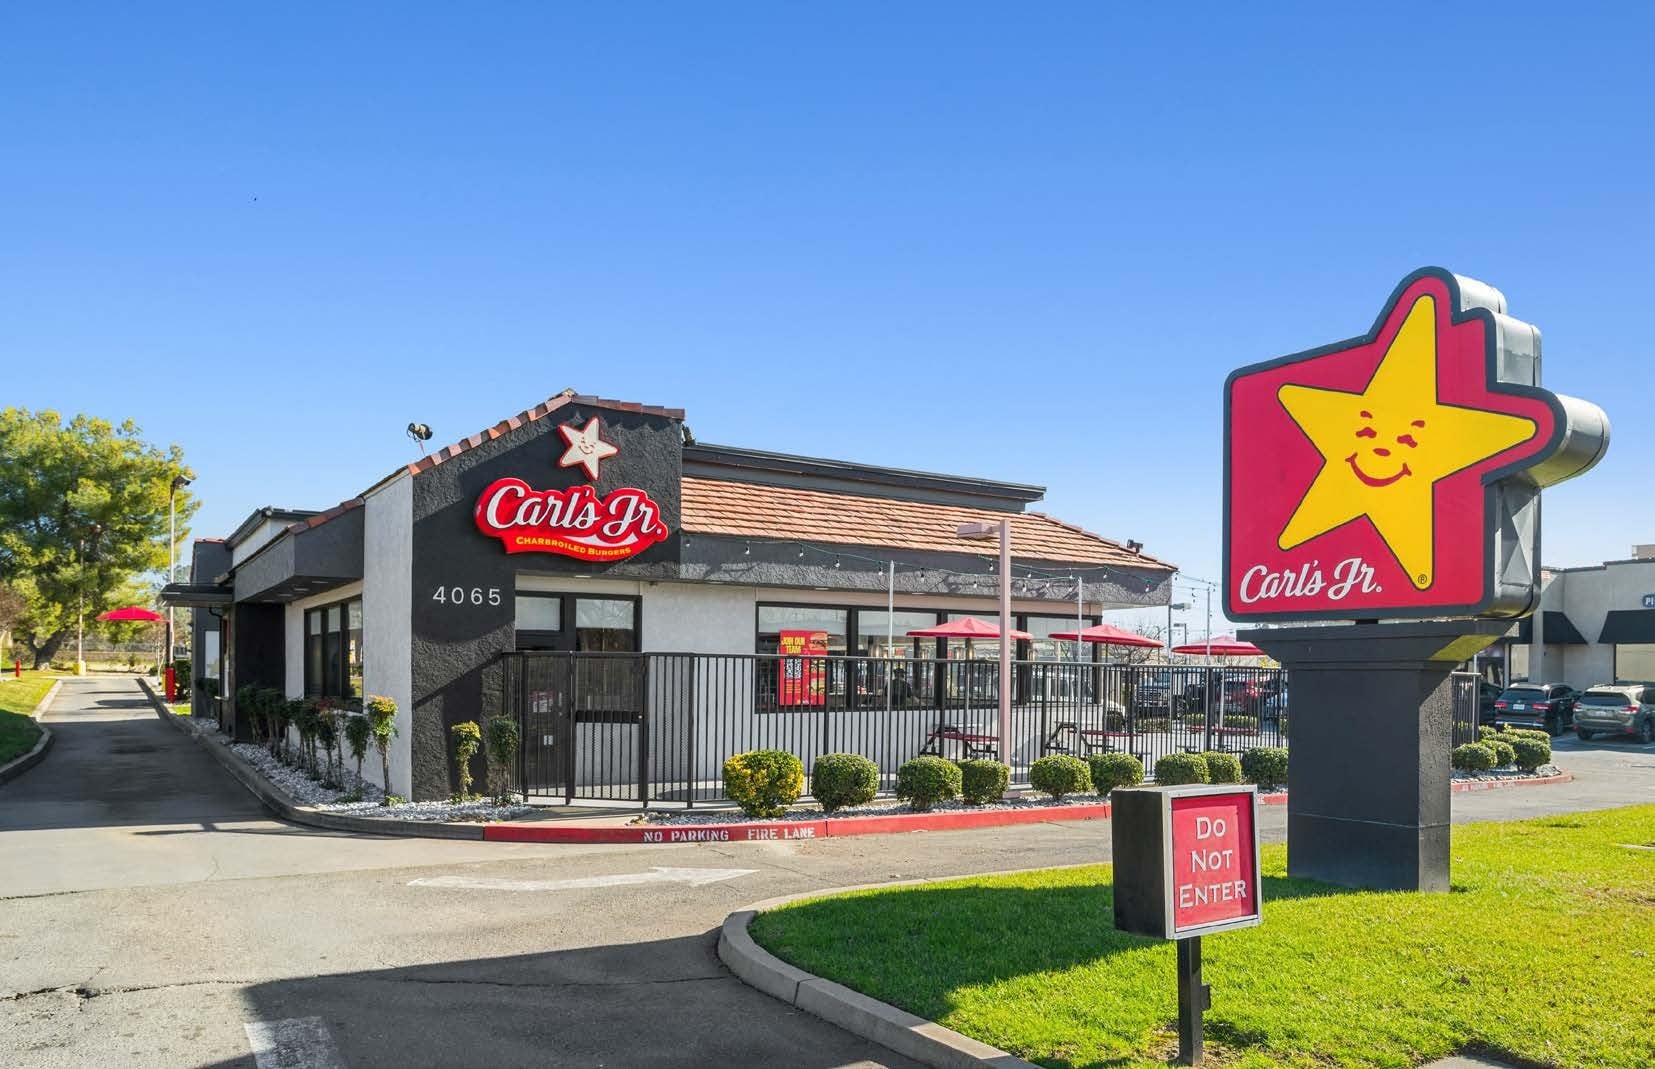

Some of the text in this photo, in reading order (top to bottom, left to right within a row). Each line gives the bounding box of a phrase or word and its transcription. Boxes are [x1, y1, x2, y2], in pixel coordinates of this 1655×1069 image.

[486, 485, 662, 536] Carl's Jr.
[432, 586, 502, 606] 4065
[1239, 557, 1383, 604] Carl's Jr.
[643, 827, 816, 843] NO PARKING FIRE LANE
